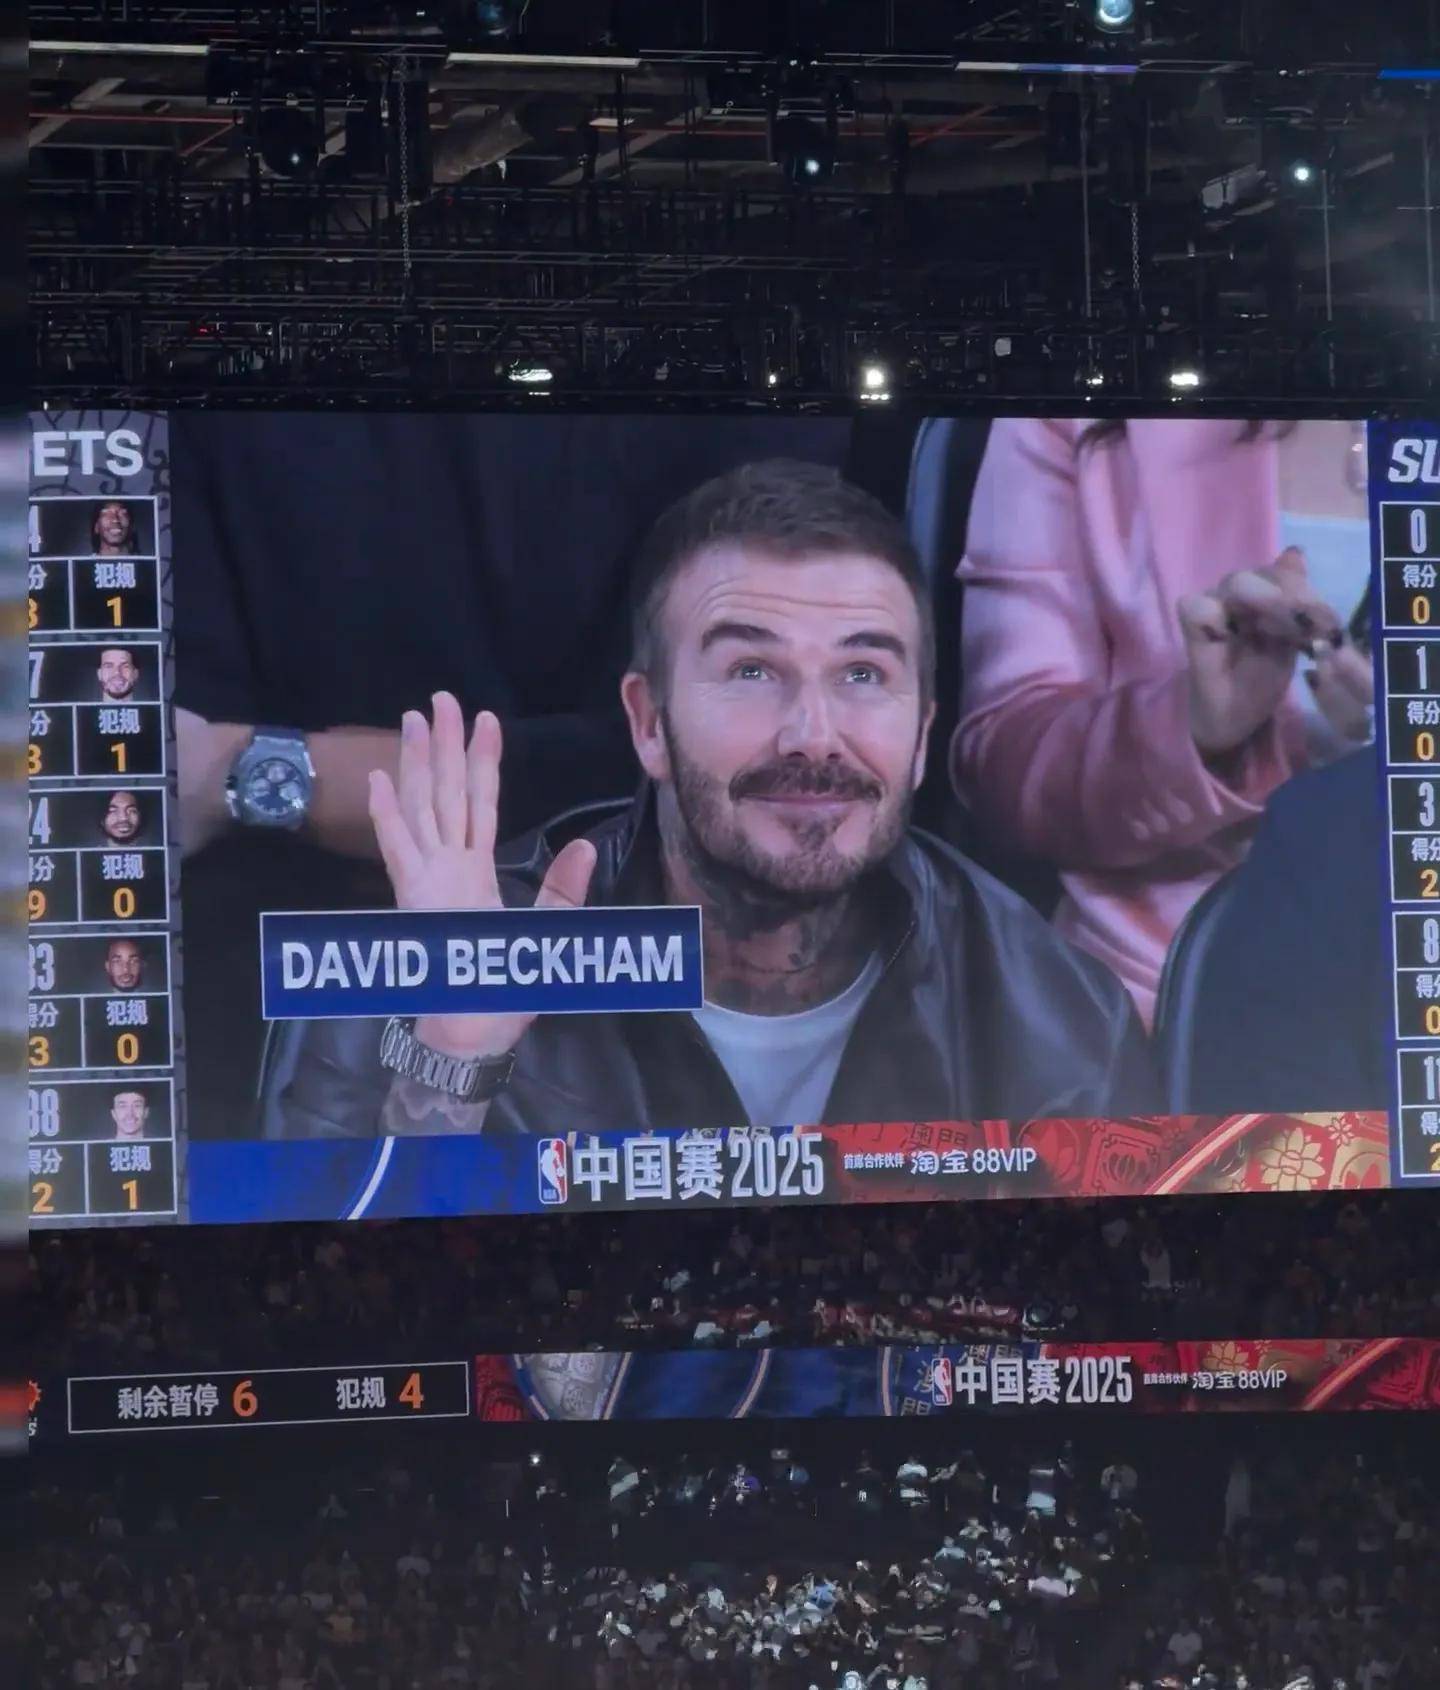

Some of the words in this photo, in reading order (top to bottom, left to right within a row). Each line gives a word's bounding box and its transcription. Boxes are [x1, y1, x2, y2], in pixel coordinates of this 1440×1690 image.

[33, 429, 144, 477] ETS
[1410, 509, 1427, 554] 0
[94, 562, 136, 588] 犯规
[1402, 564, 1437, 588] 得分
[106, 596, 122, 627] 1
[1412, 596, 1430, 624] 0
[1416, 646, 1427, 690] 1
[29, 709, 51, 736] 分
[98, 708, 140, 734] 犯规
[1407, 701, 1440, 725] 得分
[111, 743, 127, 772] 1
[1416, 732, 1434, 761] 0
[1419, 782, 1435, 827] 3
[29, 797, 51, 845] 4
[29, 855, 55, 882] 分
[102, 854, 144, 880] 犯规
[1420, 869, 1439, 897] 2
[113, 888, 135, 918] 0
[1423, 918, 1440, 963] 8
[282, 940, 429, 989] DAVID
[446, 936, 684, 986] BECKHAM
[106, 1000, 148, 1025] 犯规
[29, 1036, 49, 1066] 3
[117, 1033, 139, 1064] 0
[110, 1146, 151, 1171] 犯规
[32, 1182, 54, 1213] 2
[122, 1180, 138, 1210] 1
[118, 1383, 219, 1419] 剩余暂停
[233, 1380, 258, 1417] 6
[336, 1376, 386, 1409] 犯规
[400, 1372, 424, 1408] 4
